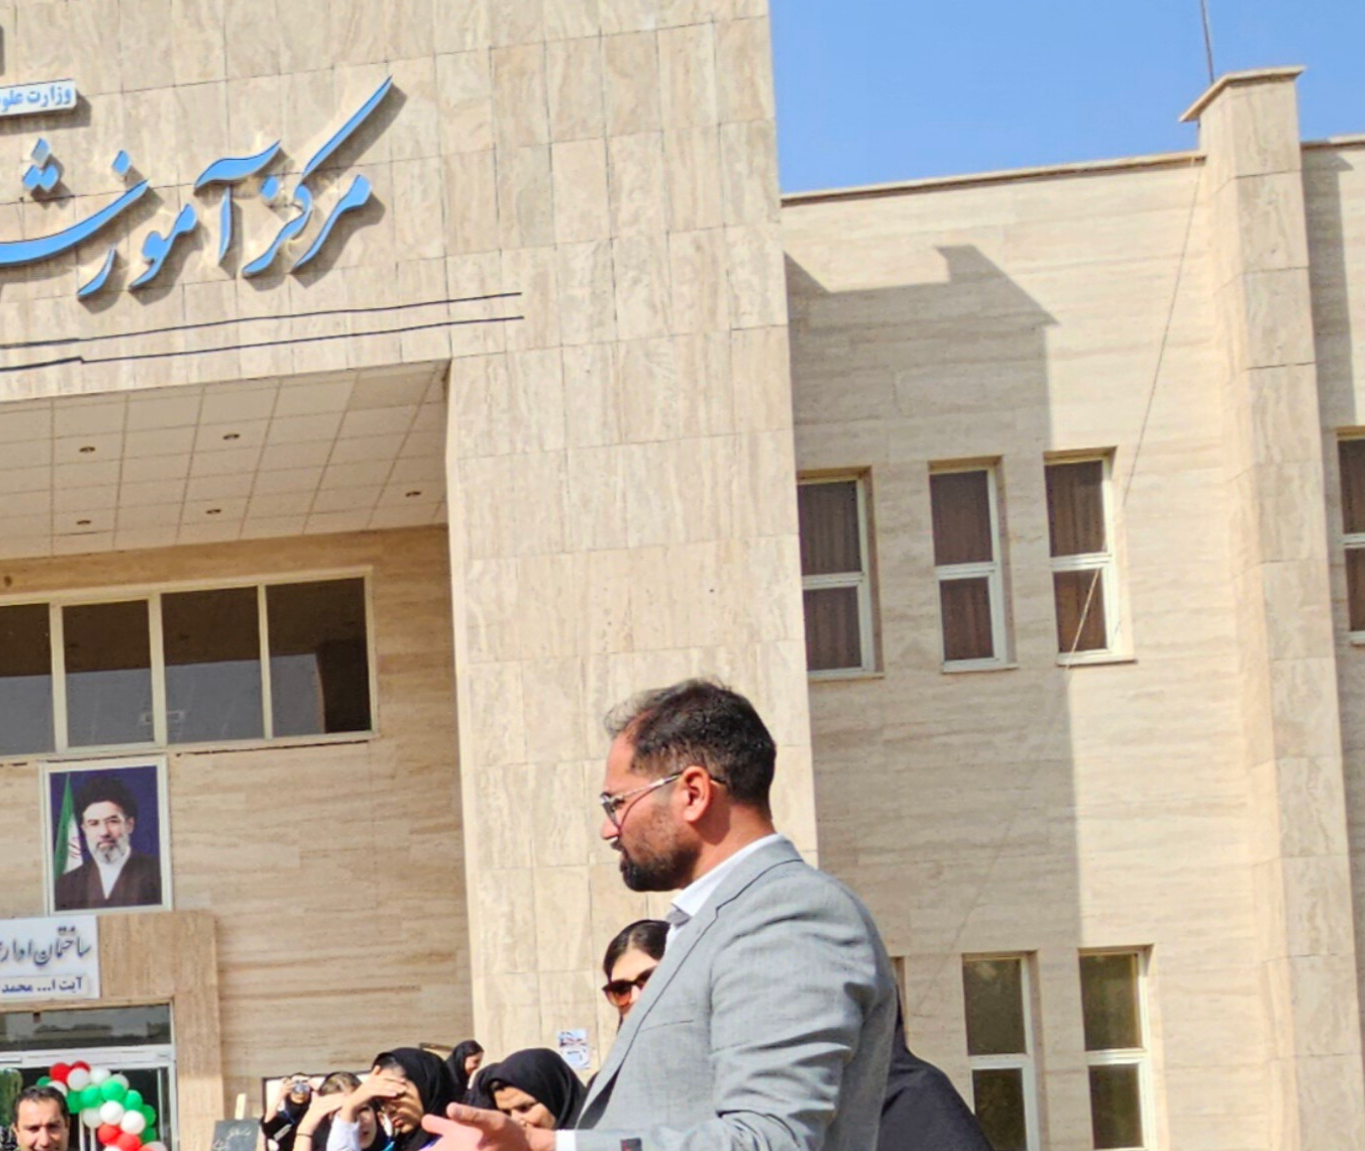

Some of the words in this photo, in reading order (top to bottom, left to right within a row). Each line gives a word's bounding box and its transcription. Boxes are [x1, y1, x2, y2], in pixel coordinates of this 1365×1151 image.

[26, 84, 72, 107] وزارت
[241, 77, 393, 276] مرکز
[34, 926, 92, 968] ساختمان
[1, 983, 33, 994] محمد
[58, 976, 82, 994] آیت
